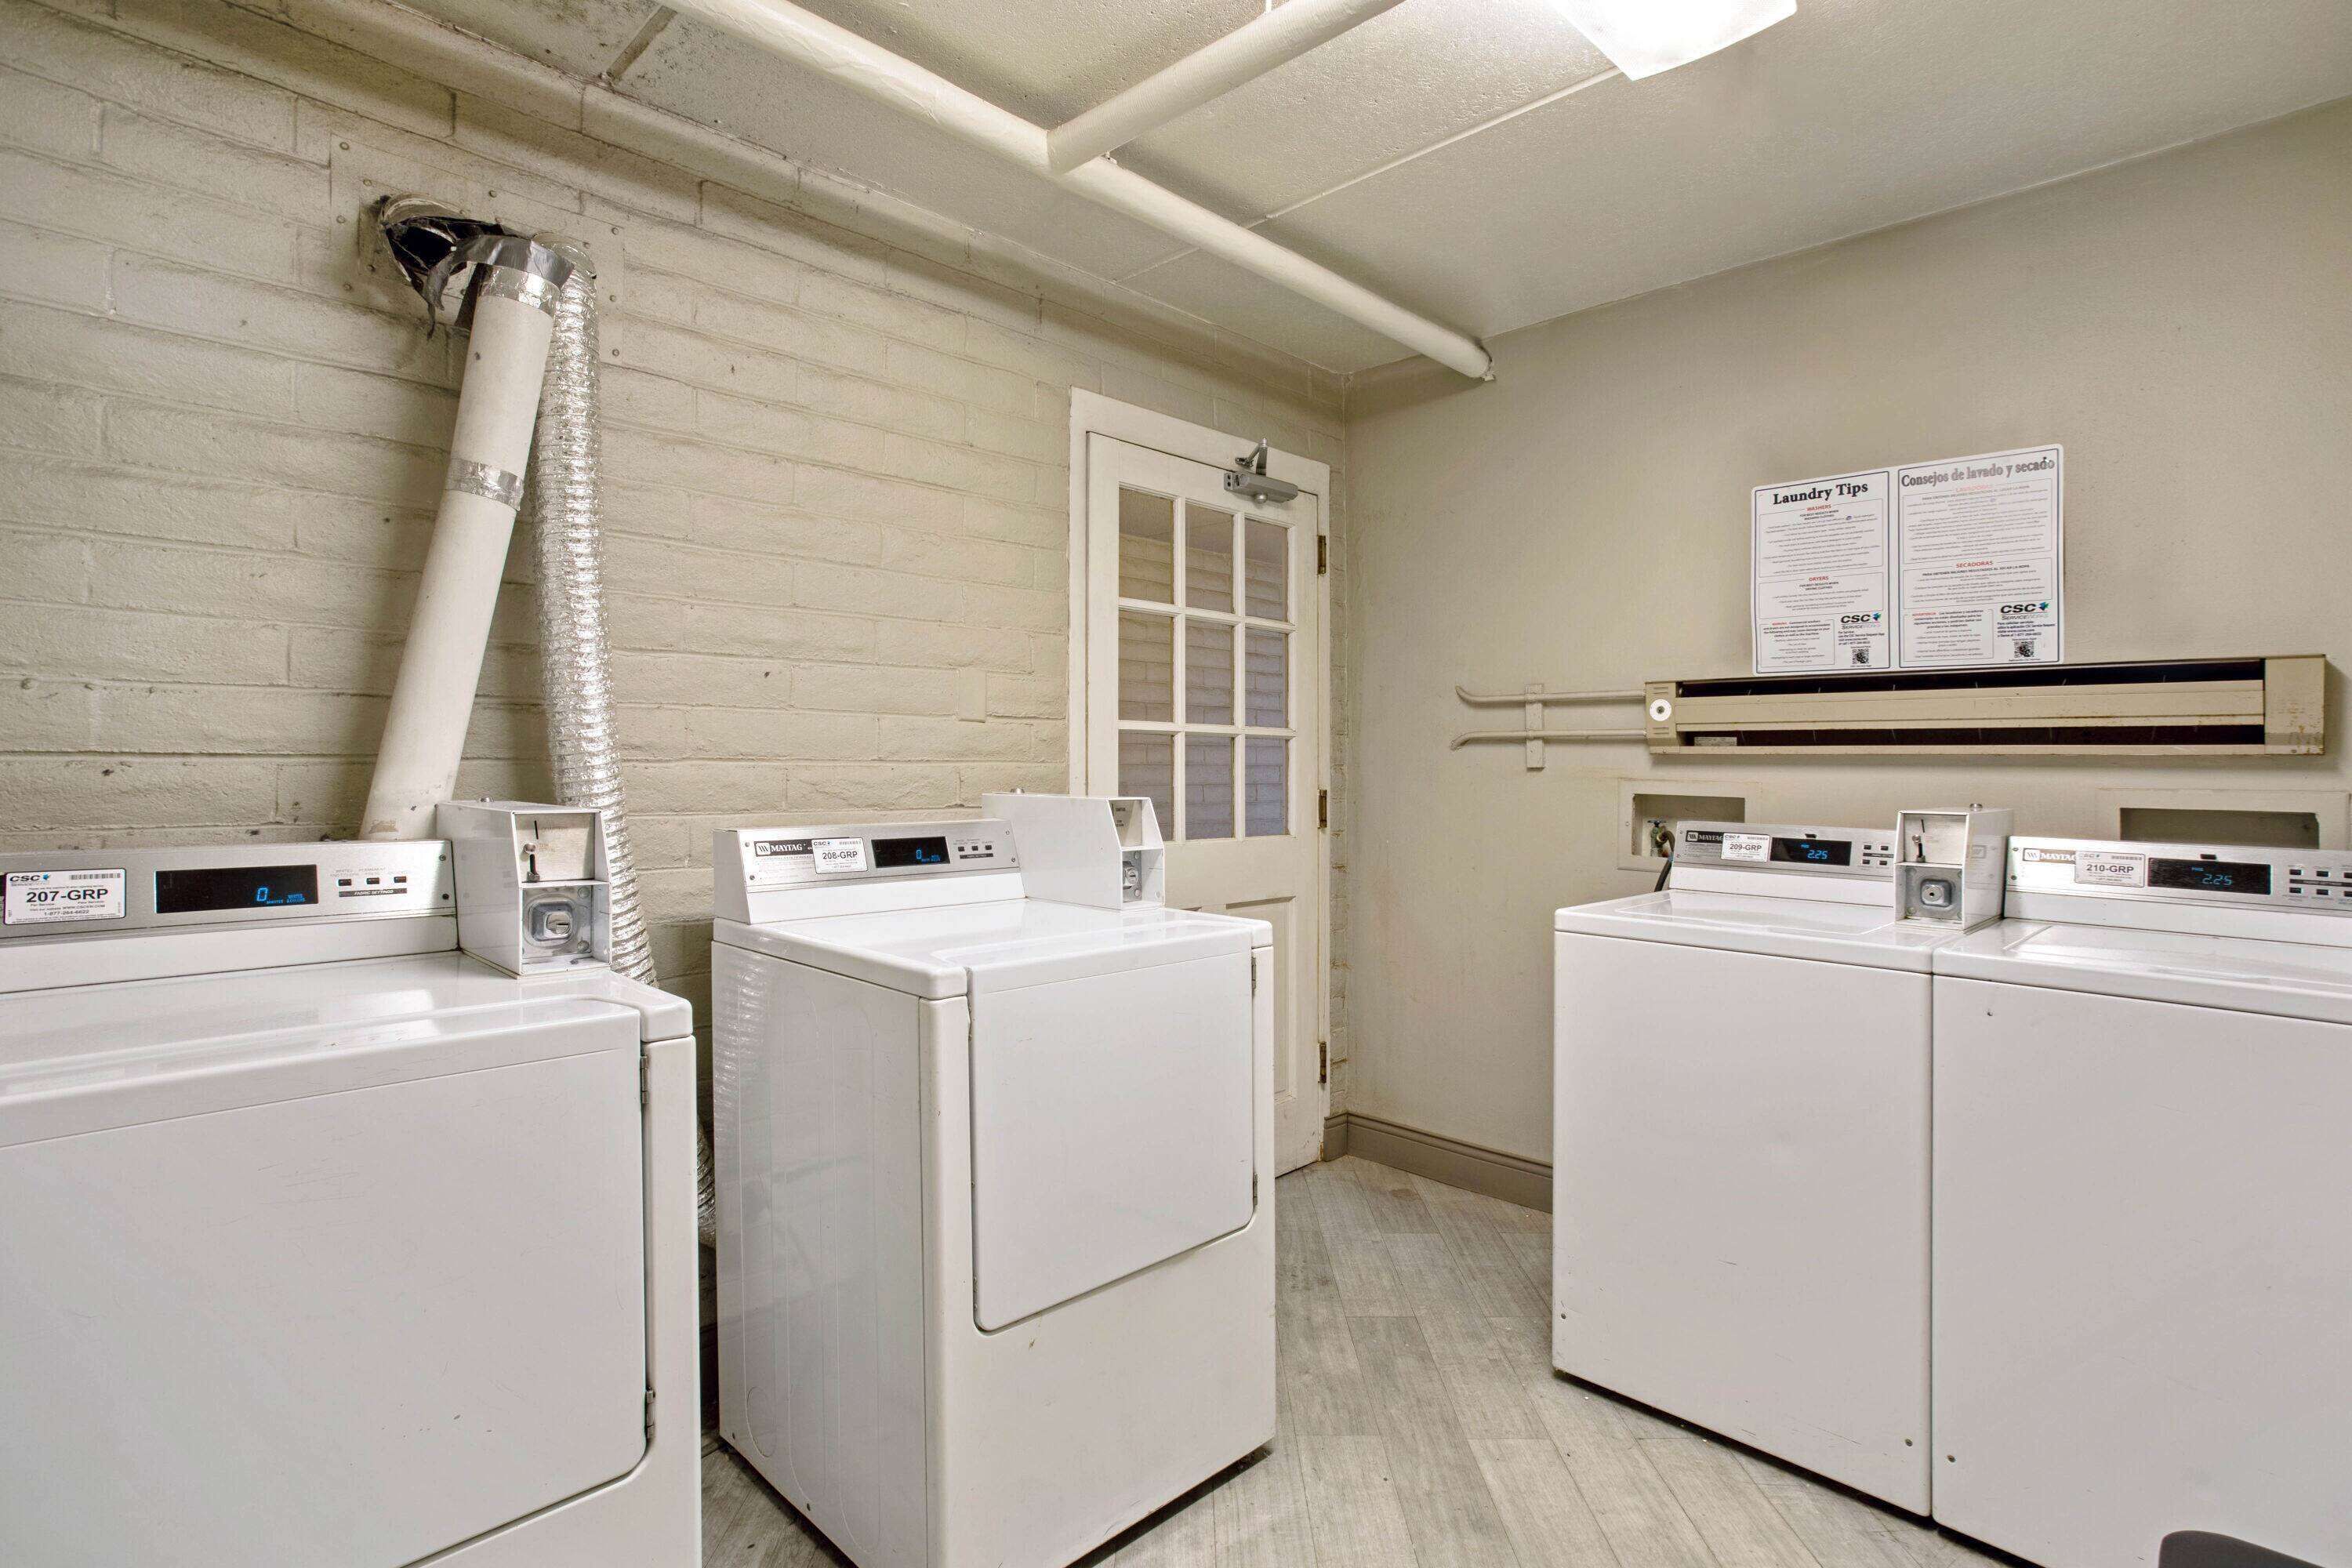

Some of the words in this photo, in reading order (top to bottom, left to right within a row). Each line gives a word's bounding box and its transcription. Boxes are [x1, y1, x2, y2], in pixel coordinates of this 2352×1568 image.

[1901, 472, 1949, 487] Consejos
[1951, 470, 1964, 481] de
[1966, 463, 2004, 480] lavado
[2006, 465, 2013, 477] y
[2015, 456, 2056, 474] secado
[1773, 488, 1832, 505] Laundry
[1836, 483, 1868, 497] Tips
[2000, 604, 2036, 613] CSC
[1841, 614, 1871, 623] CSC
[770, 844, 803, 852] MAYTAG
[1730, 843, 1762, 851] 209-GRP
[822, 851, 858, 860] 208-GRP
[916, 849, 922, 859] 0
[1807, 849, 1828, 860] 2.25
[2086, 863, 2134, 873] 210-GRP
[2201, 873, 2233, 886] 2.25
[27, 888, 108, 902] 207-GRP
[256, 887, 269, 902] 0
